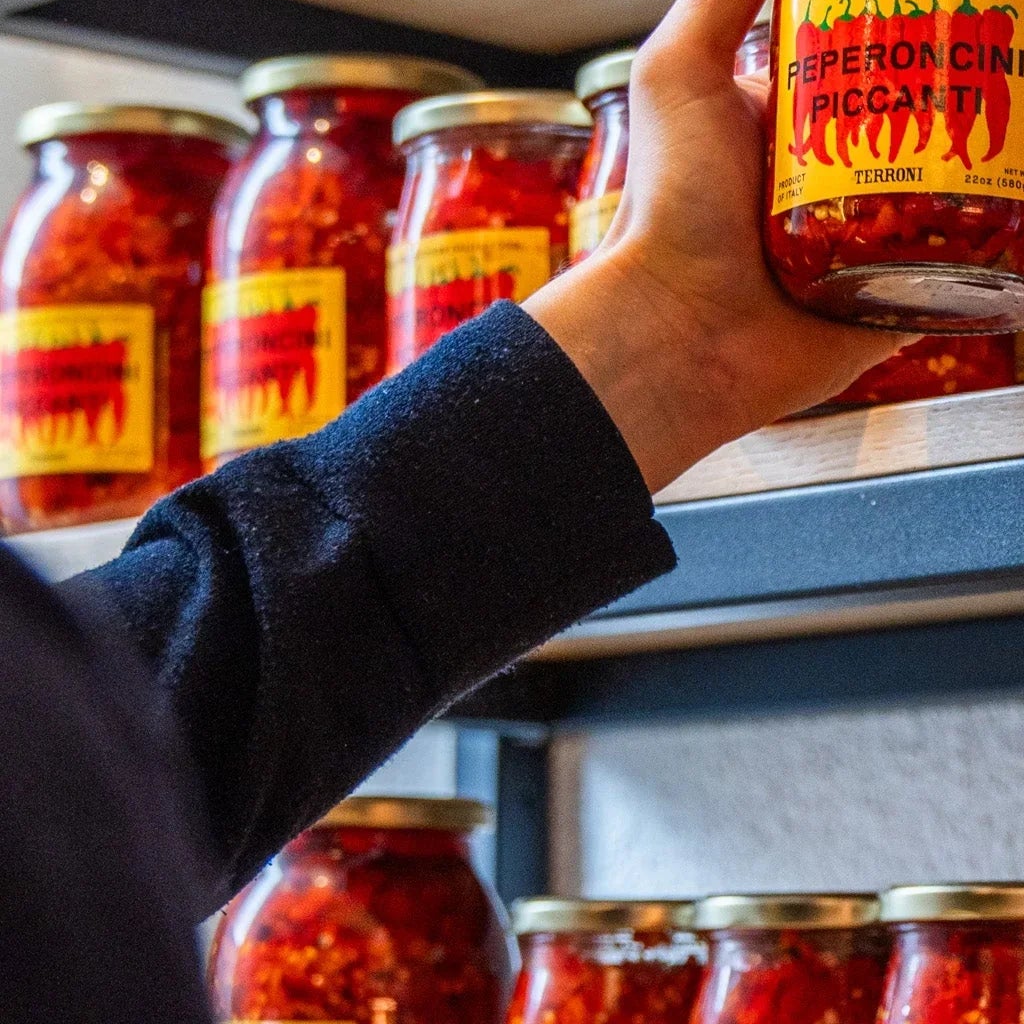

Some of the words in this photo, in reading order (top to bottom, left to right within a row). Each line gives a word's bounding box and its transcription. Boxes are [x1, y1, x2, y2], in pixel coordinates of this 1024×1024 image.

[812, 85, 982, 124] PICCANTI
[855, 167, 923, 185] TERRONI
[965, 174, 992, 185] 22oz
[1004, 167, 1018, 176] NET
[778, 173, 806, 191] PRODUCT
[777, 191, 785, 203] OF
[786, 186, 804, 200] ITALY
